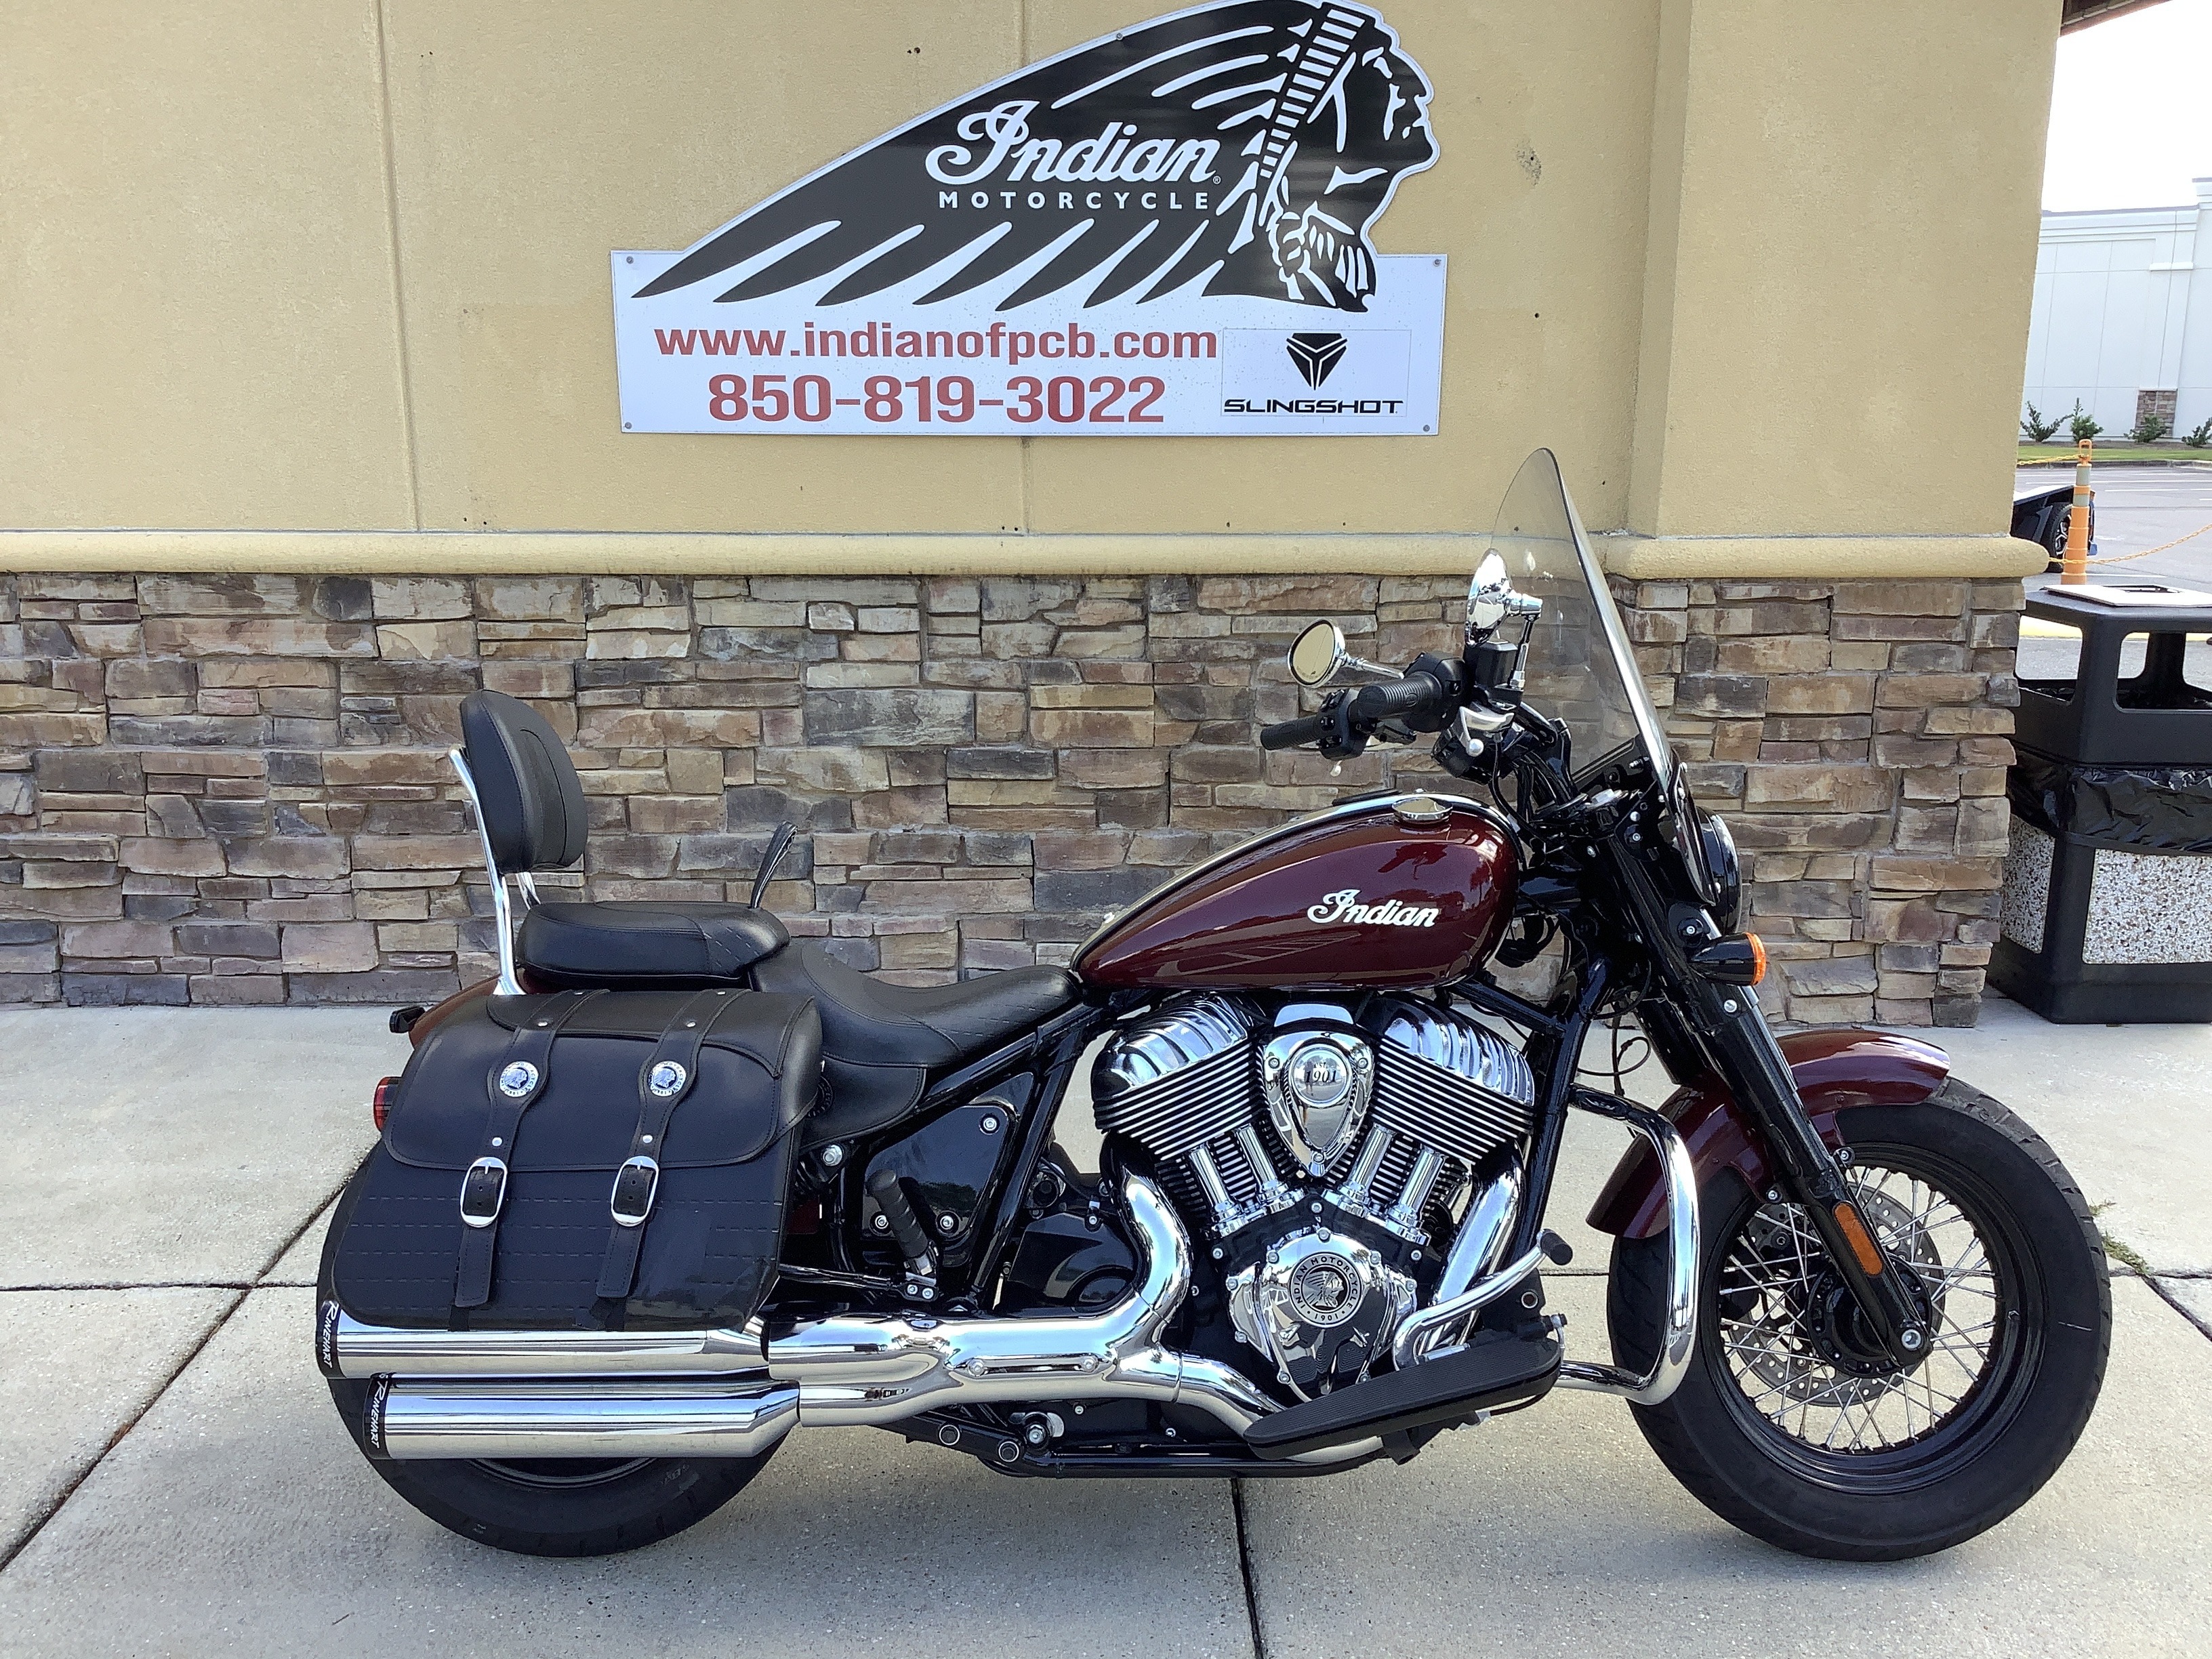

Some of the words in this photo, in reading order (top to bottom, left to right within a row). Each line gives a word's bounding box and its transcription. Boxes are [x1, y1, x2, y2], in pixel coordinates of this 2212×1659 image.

[925, 100, 1221, 184] Indian
[939, 190, 1209, 209] MOTORCYCLE
[654, 322, 1217, 365] www.indianofpcb.com
[708, 374, 1166, 423] 850-819-3022
[1223, 398, 1404, 414] SLINGSHOT
[1307, 889, 1439, 928] Indian
[1305, 1070, 1337, 1083] 1901
[1294, 1265, 1308, 1309] INDIAN
[1310, 1256, 1359, 1309] MOTORCYCLE
[323, 1300, 340, 1368] RINEHART
[1315, 1313, 1339, 1322] 1901
[370, 1380, 388, 1449] RINEHART
